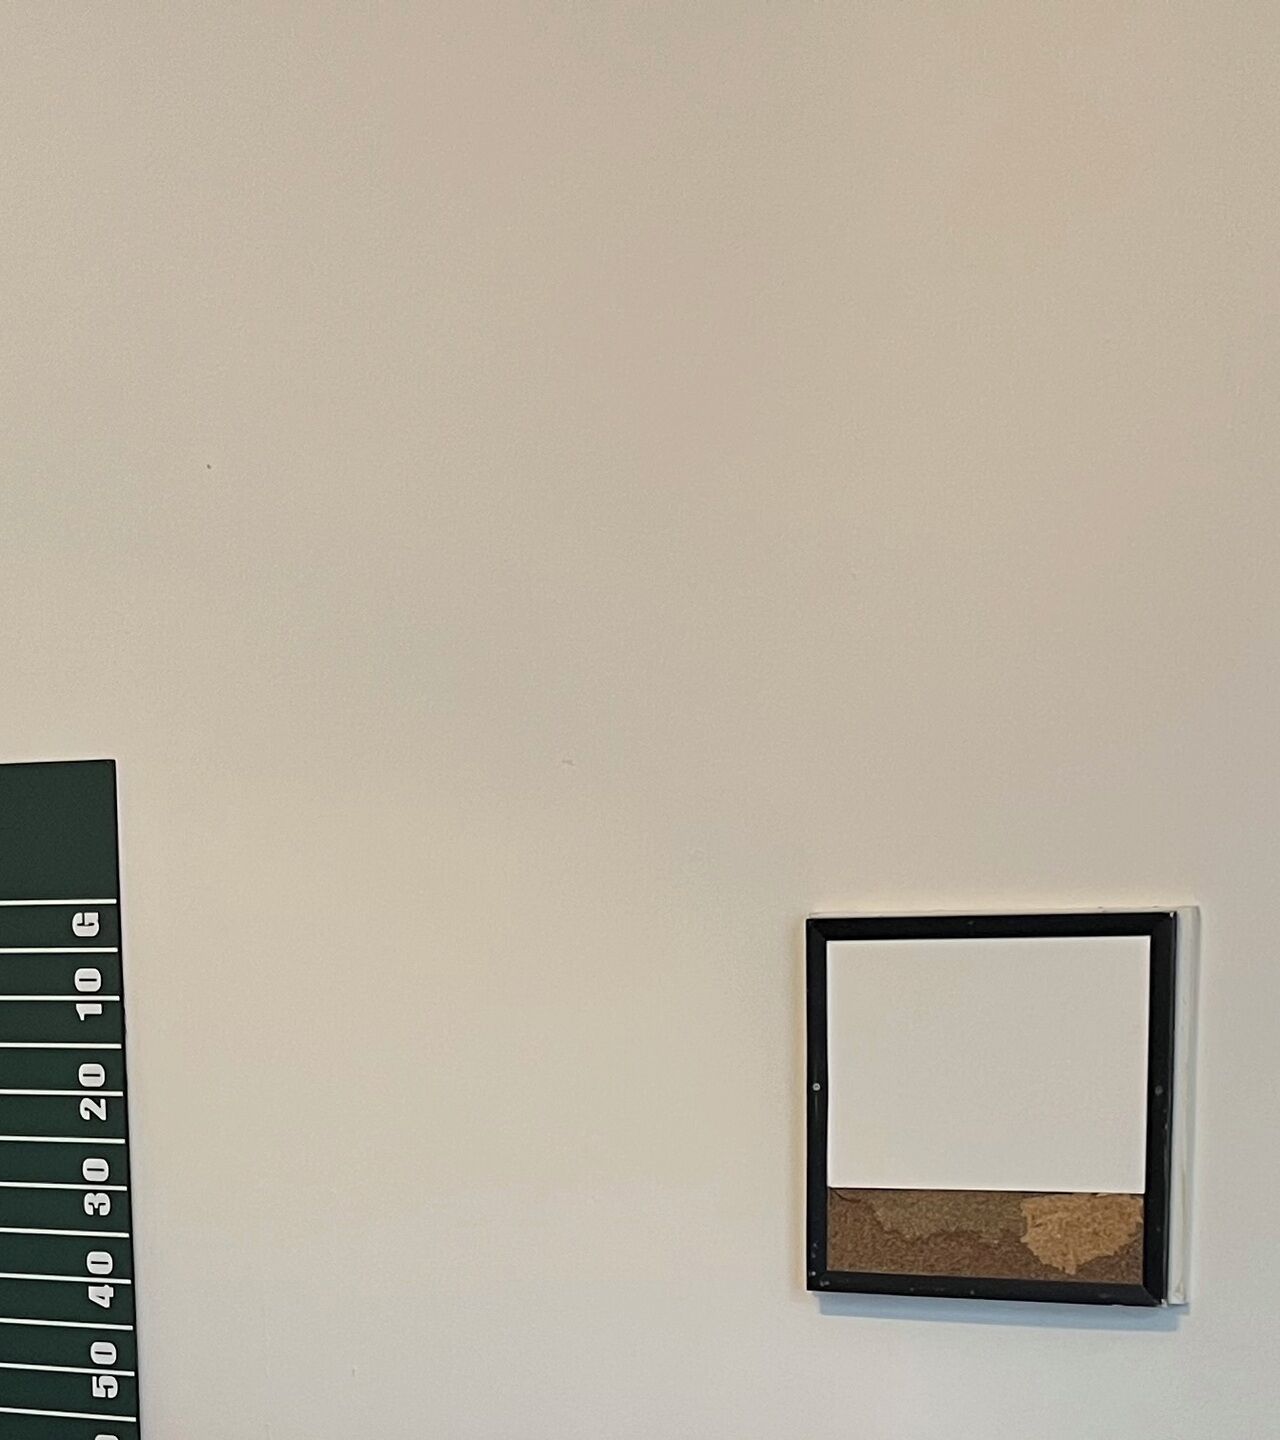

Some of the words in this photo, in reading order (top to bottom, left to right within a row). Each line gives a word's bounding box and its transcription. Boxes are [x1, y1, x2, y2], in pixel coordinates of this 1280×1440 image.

[71, 911, 100, 939] G
[73, 967, 104, 1023] 10
[77, 1062, 108, 1122] 20
[82, 1157, 112, 1217] 30
[86, 1250, 115, 1309] 40
[90, 1341, 119, 1400] 50
